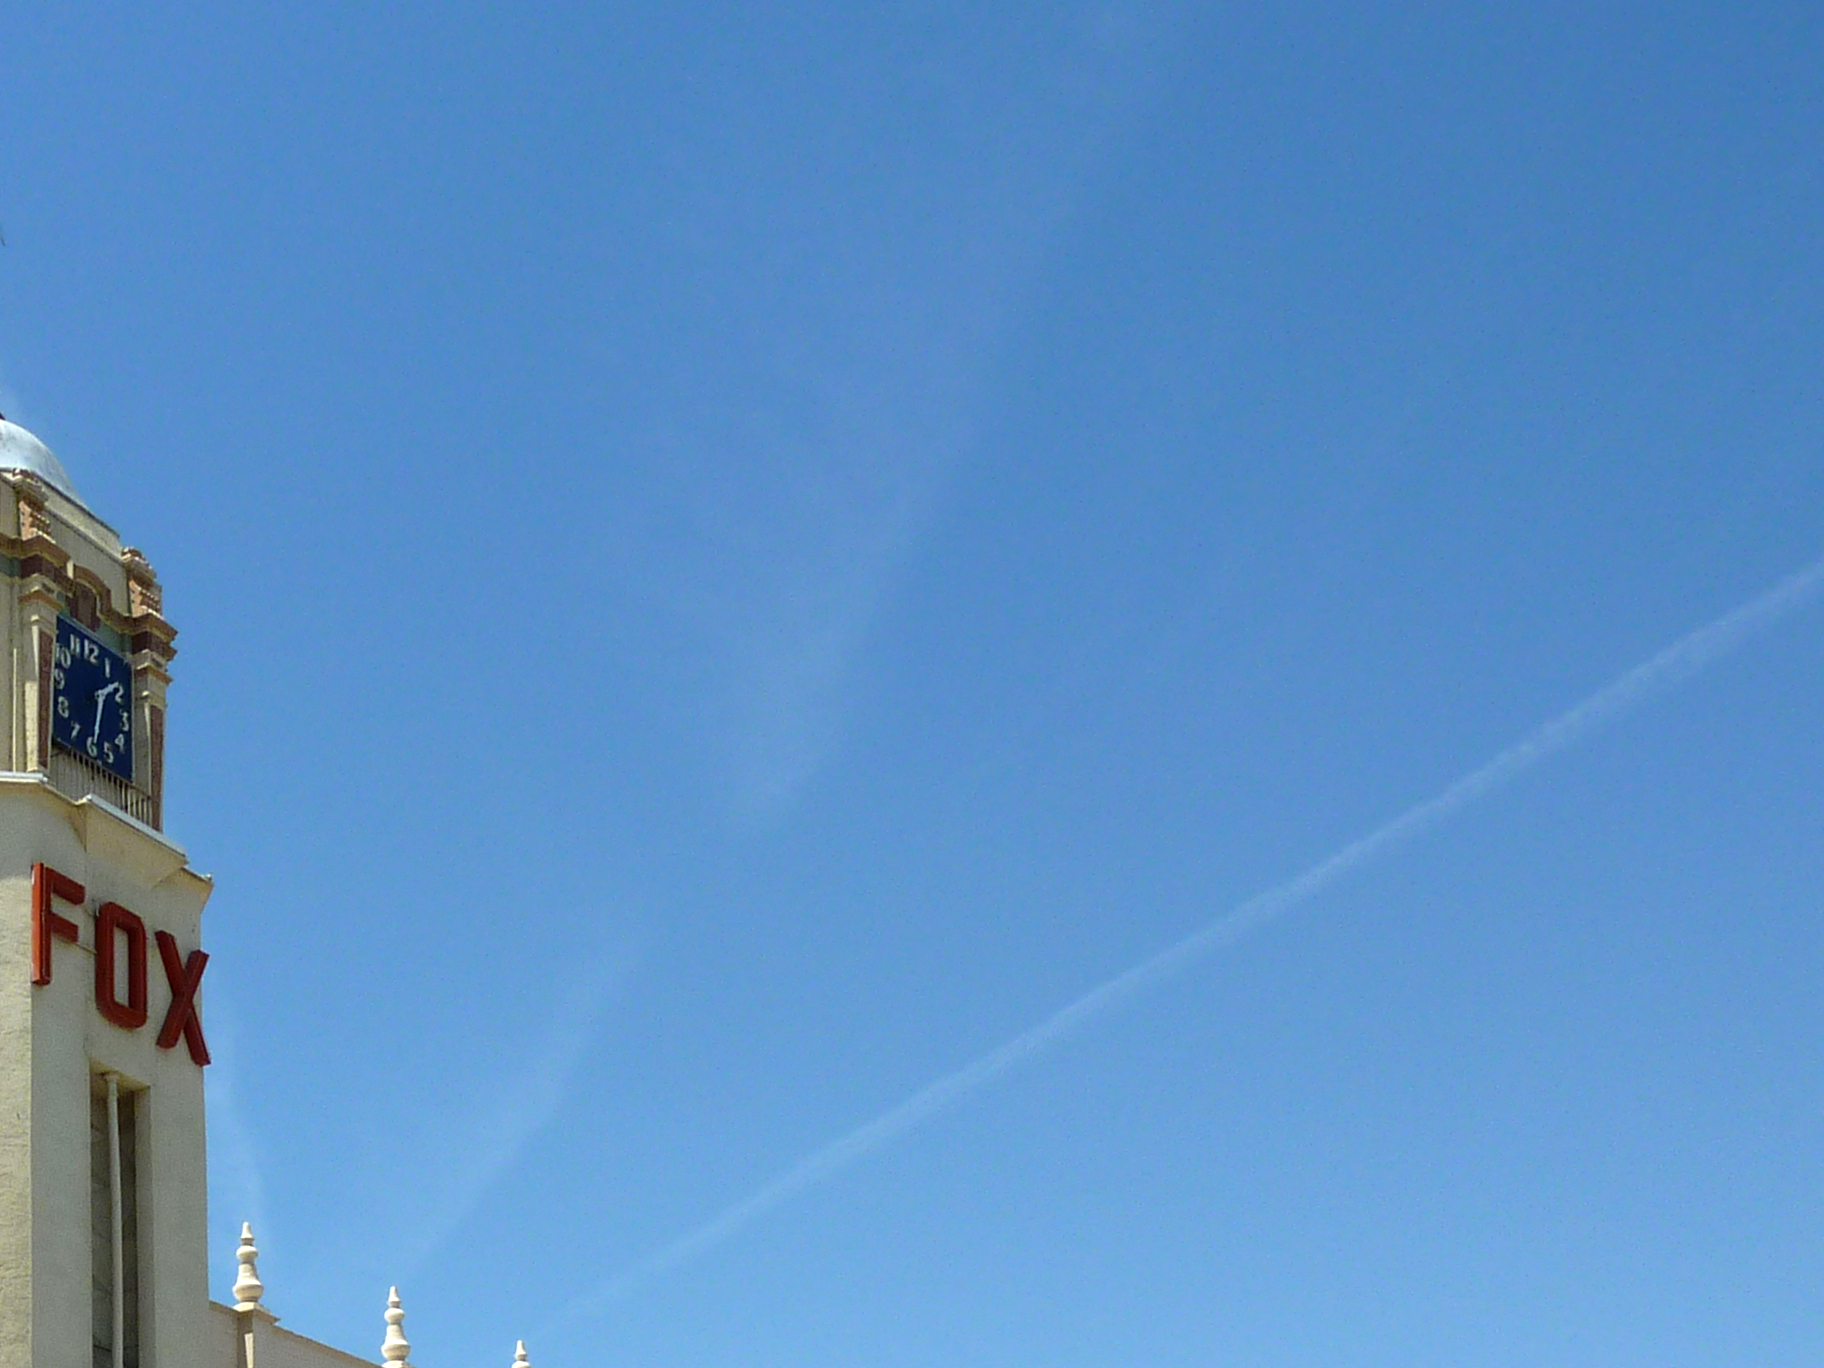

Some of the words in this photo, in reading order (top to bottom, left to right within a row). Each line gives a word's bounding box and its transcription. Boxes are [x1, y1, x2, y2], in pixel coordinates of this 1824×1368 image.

[55, 643, 71, 669] 10
[70, 634, 81, 658] 11
[84, 639, 99, 665] 12
[55, 668, 65, 690] 9
[105, 657, 111, 678] 1
[114, 684, 124, 703] 2
[58, 696, 69, 719] 8
[71, 720, 81, 740] 7
[120, 709, 129, 732] 3
[87, 737, 97, 758] 6
[104, 741, 114, 764] 5
[115, 733, 125, 753] 4
[31, 862, 212, 1067] FOX
